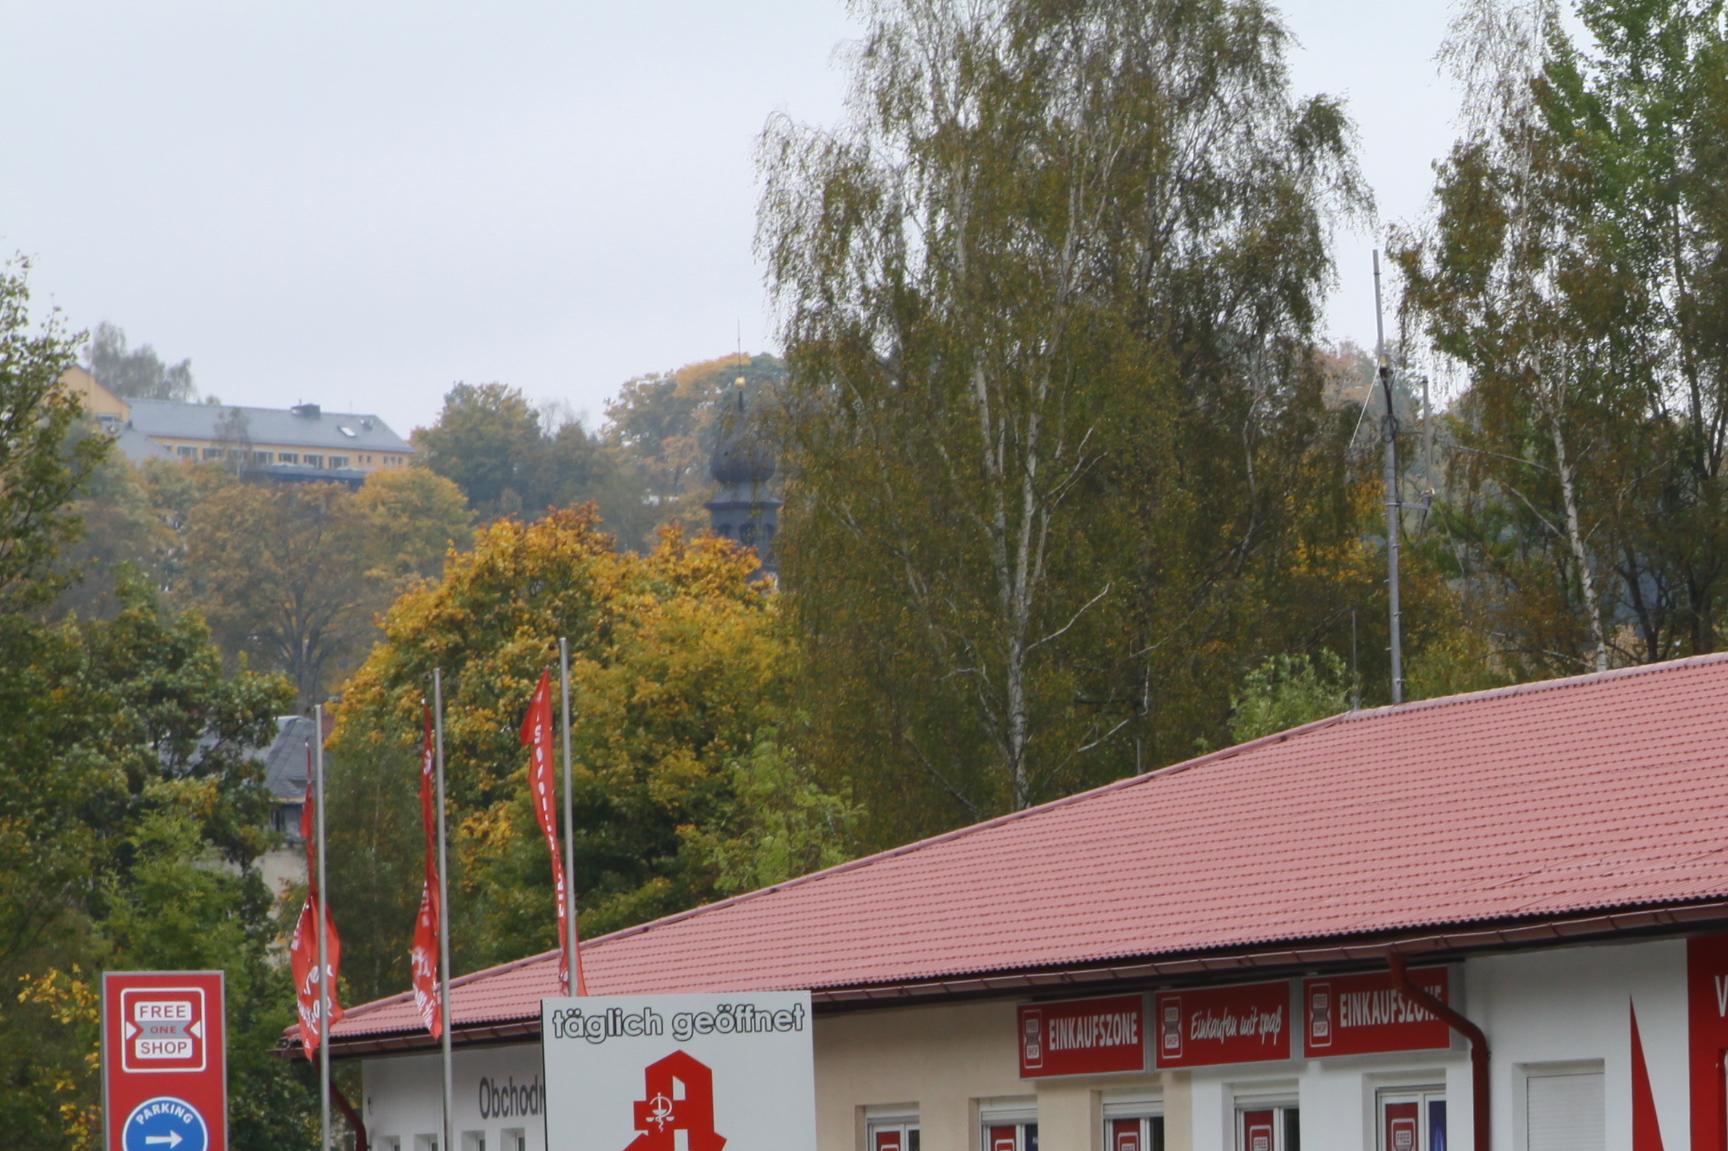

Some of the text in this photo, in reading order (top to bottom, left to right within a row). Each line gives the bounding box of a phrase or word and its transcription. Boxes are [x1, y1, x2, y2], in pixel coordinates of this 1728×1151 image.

[139, 1005, 186, 1018] FREE
[151, 1026, 177, 1034] ONE
[552, 1003, 805, 1044] täglich geöffnet
[1048, 1012, 1138, 1050] EINKAUFSZONE
[1190, 1006, 1237, 1045] Einkaufen
[141, 1042, 188, 1054] SHOP
[135, 1103, 194, 1125] PARKING
